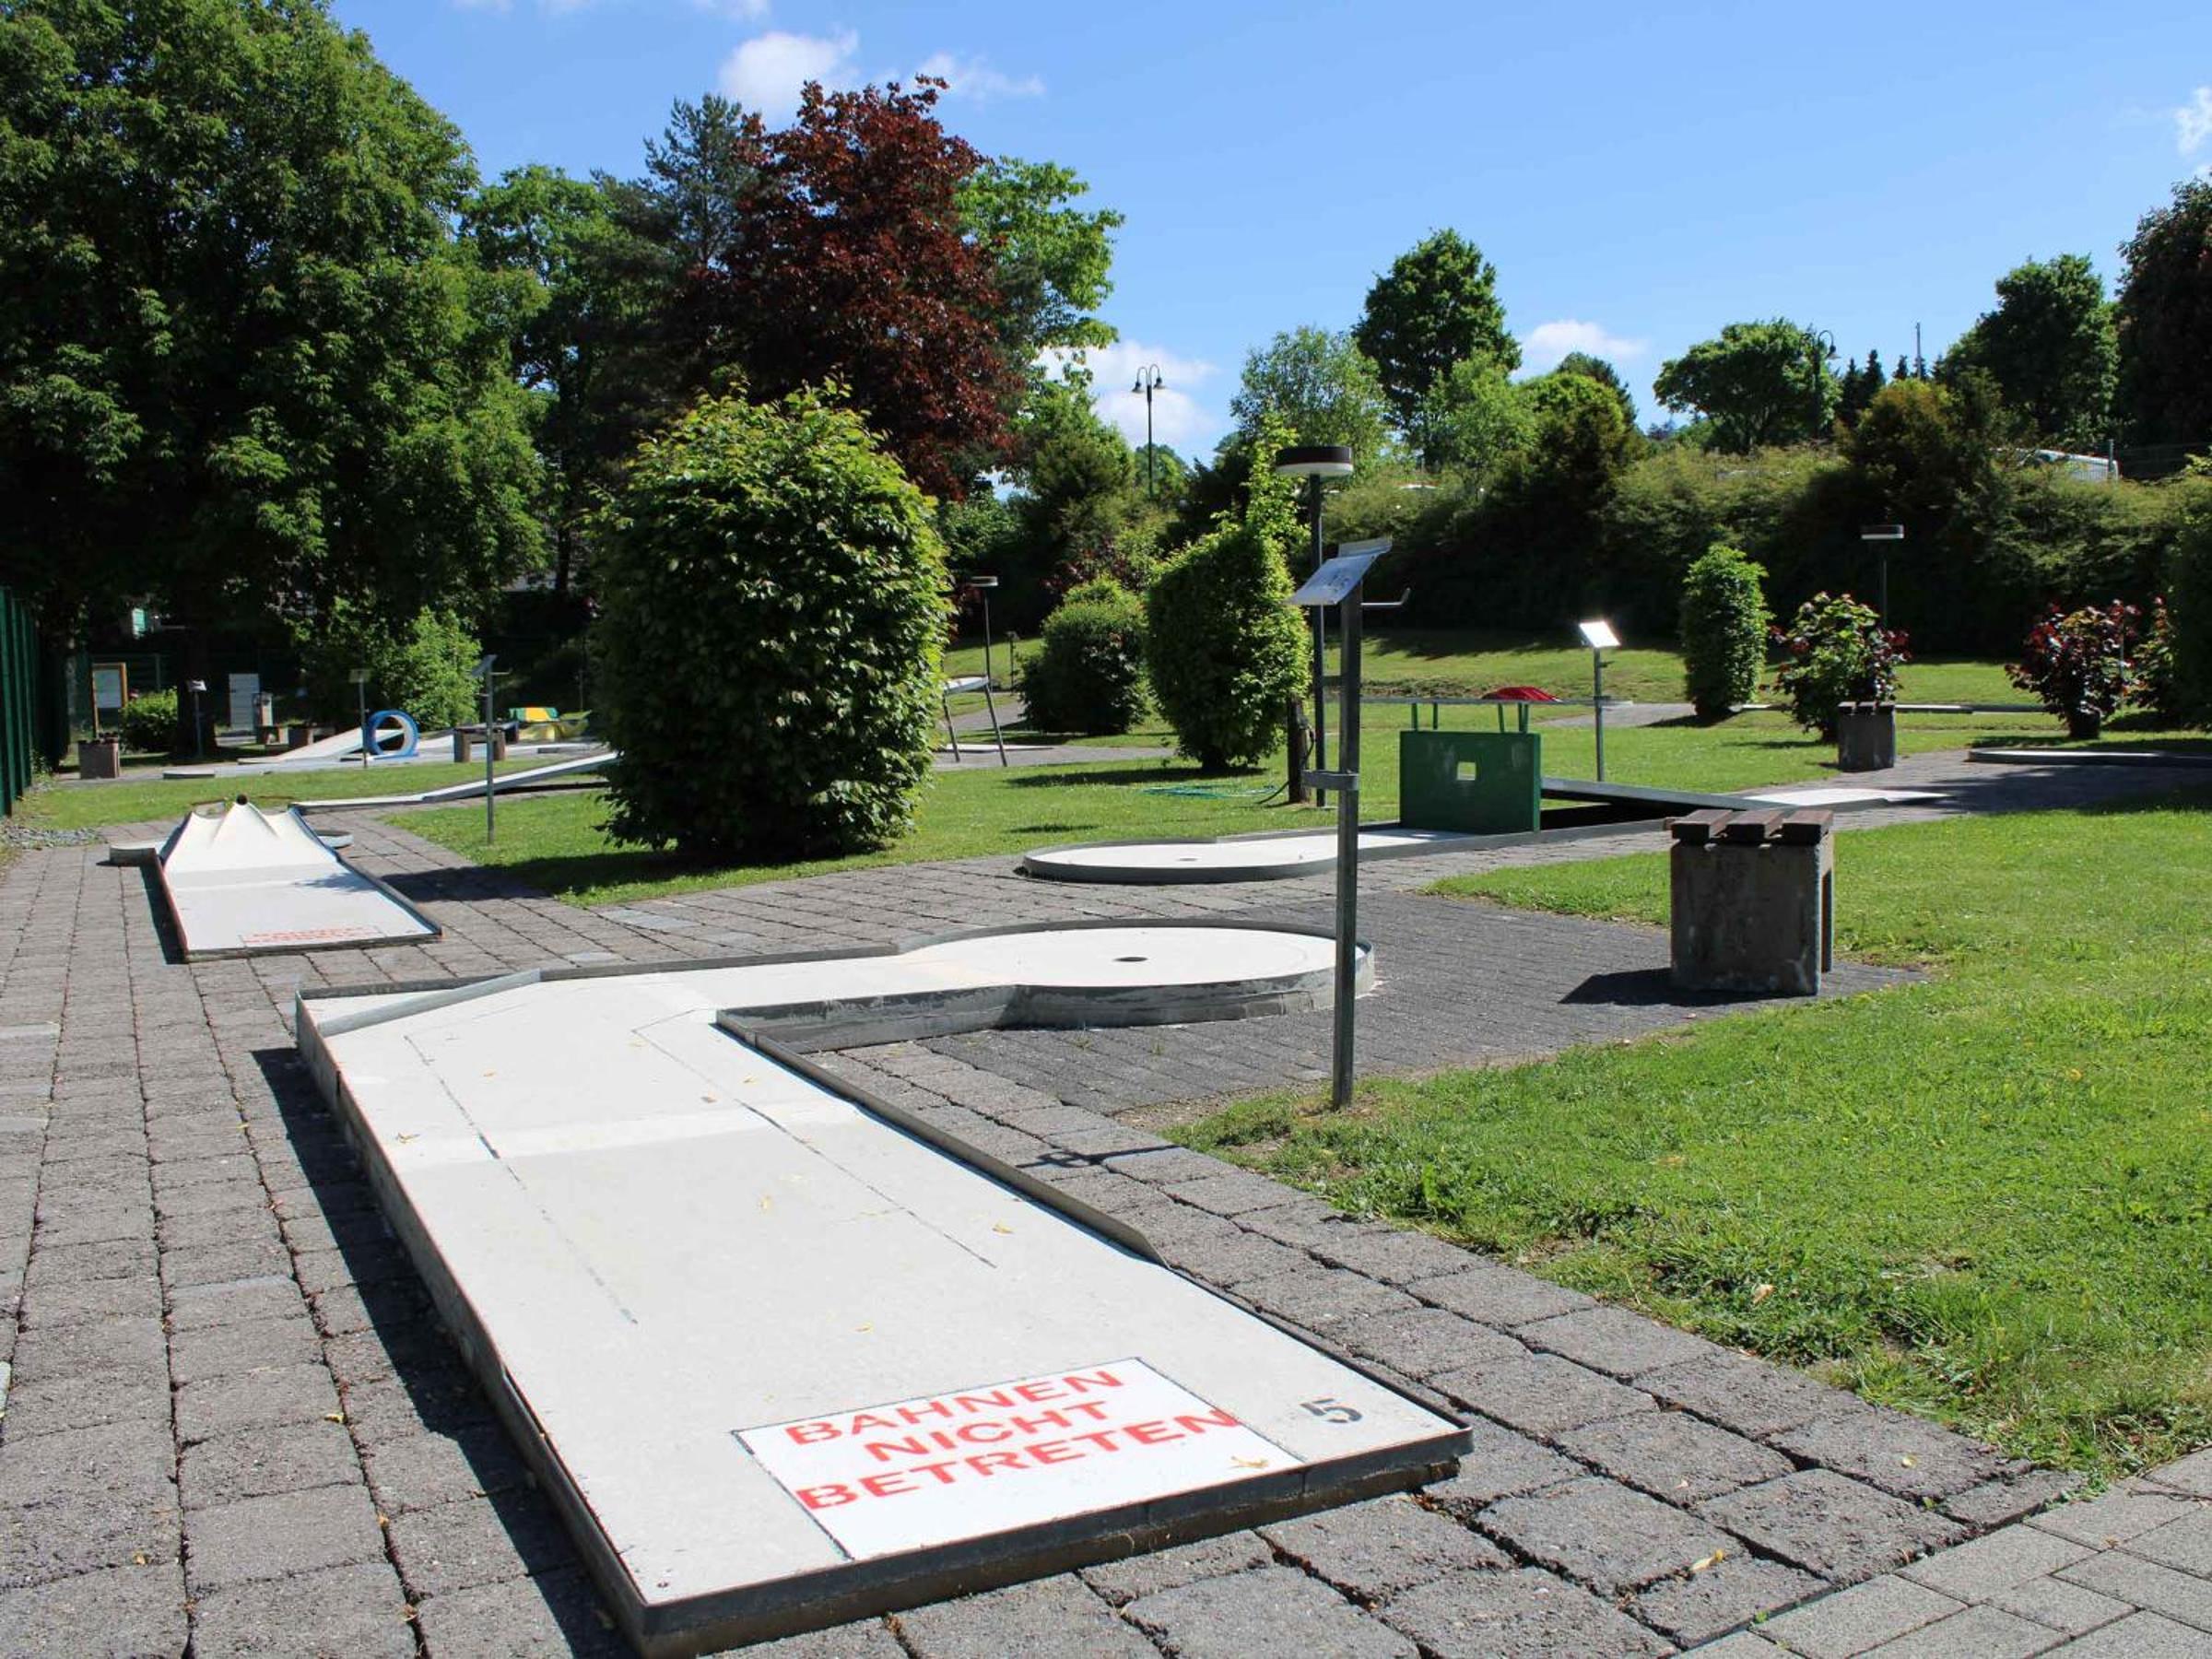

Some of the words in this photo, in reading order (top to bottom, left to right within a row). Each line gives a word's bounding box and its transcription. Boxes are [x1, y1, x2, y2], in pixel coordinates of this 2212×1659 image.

[785, 1371, 1124, 1446] BAHNEN
[865, 1401, 1110, 1463] NICHT
[1300, 1397, 1363, 1424] 5
[796, 1410, 1241, 1511] BETRETEN
